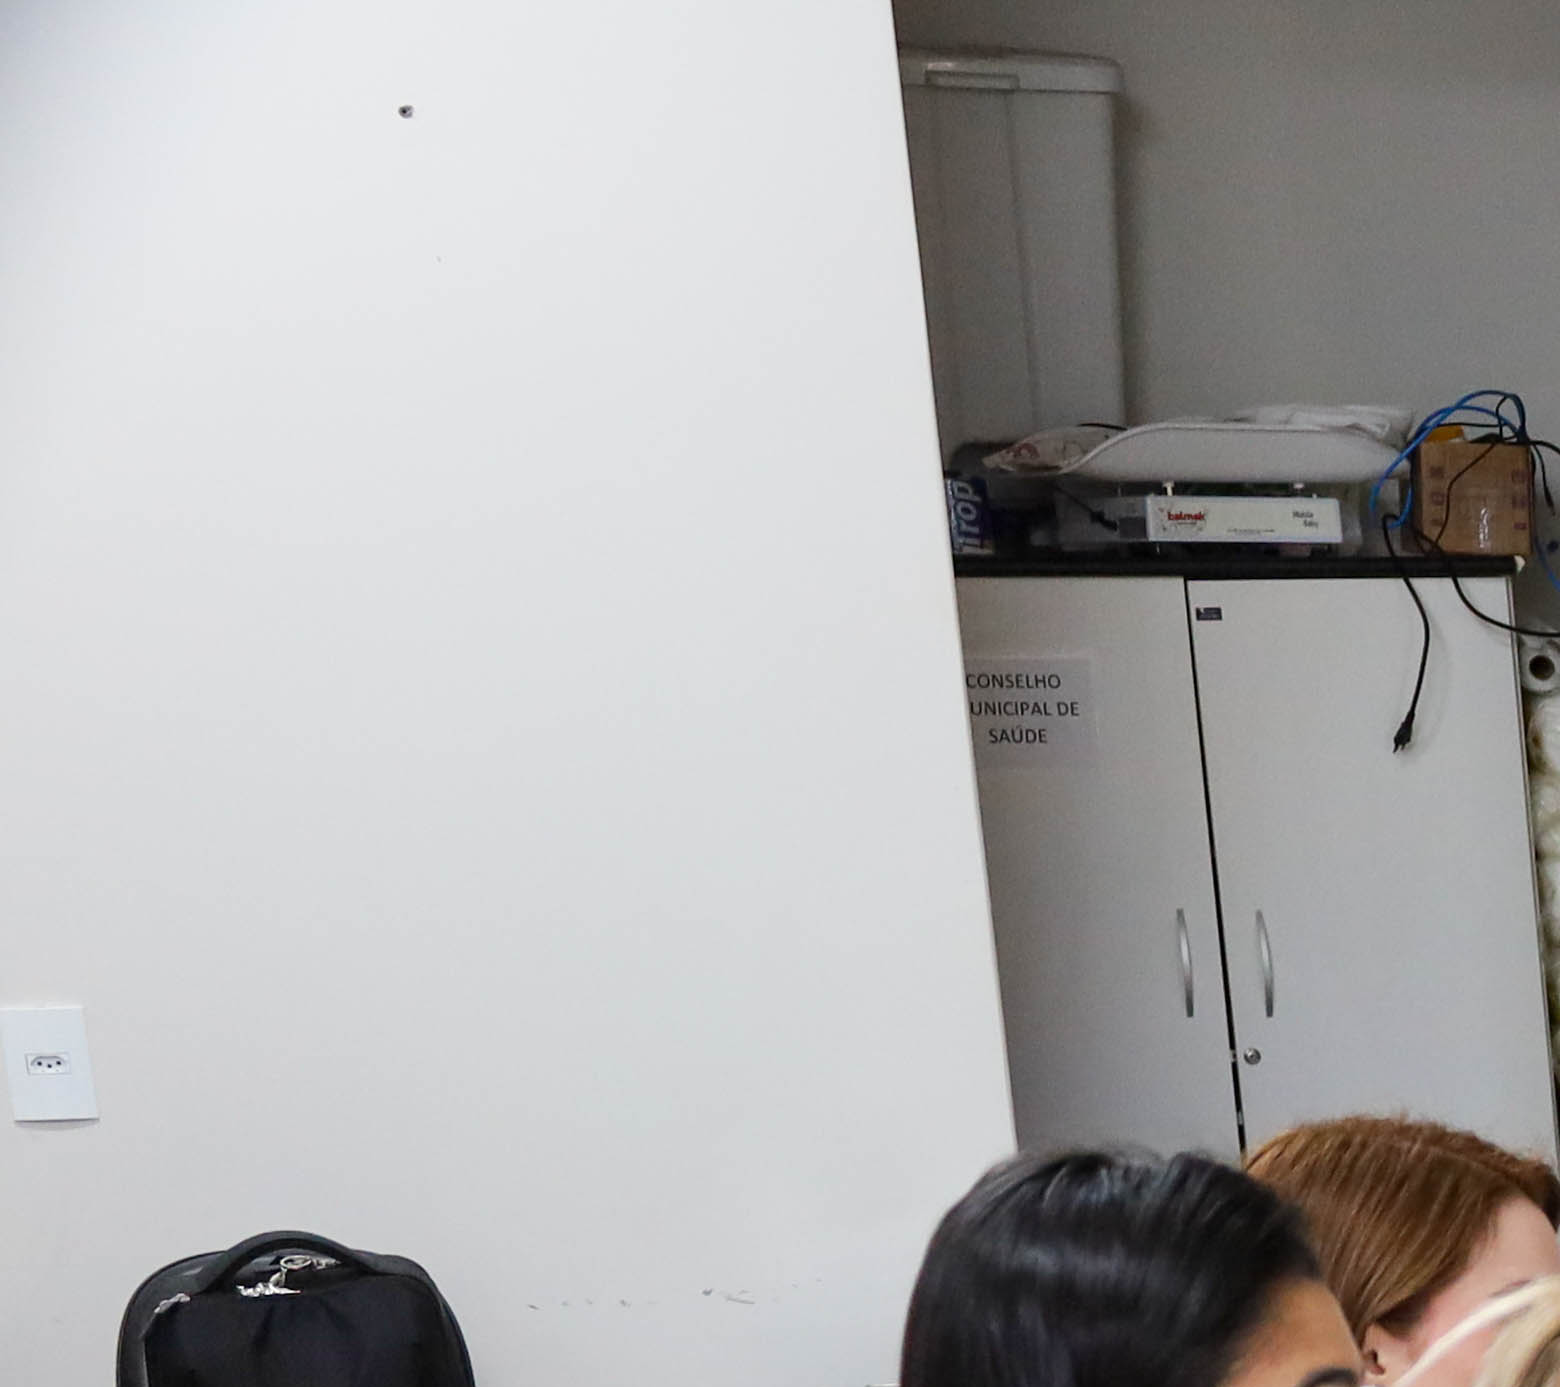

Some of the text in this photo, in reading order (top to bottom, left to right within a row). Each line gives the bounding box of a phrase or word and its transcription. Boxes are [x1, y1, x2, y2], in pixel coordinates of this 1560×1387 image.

[966, 674, 1061, 689] CONSELHO
[970, 702, 1080, 716] UNICIPAL DE
[989, 725, 1048, 744] SAÚDE
